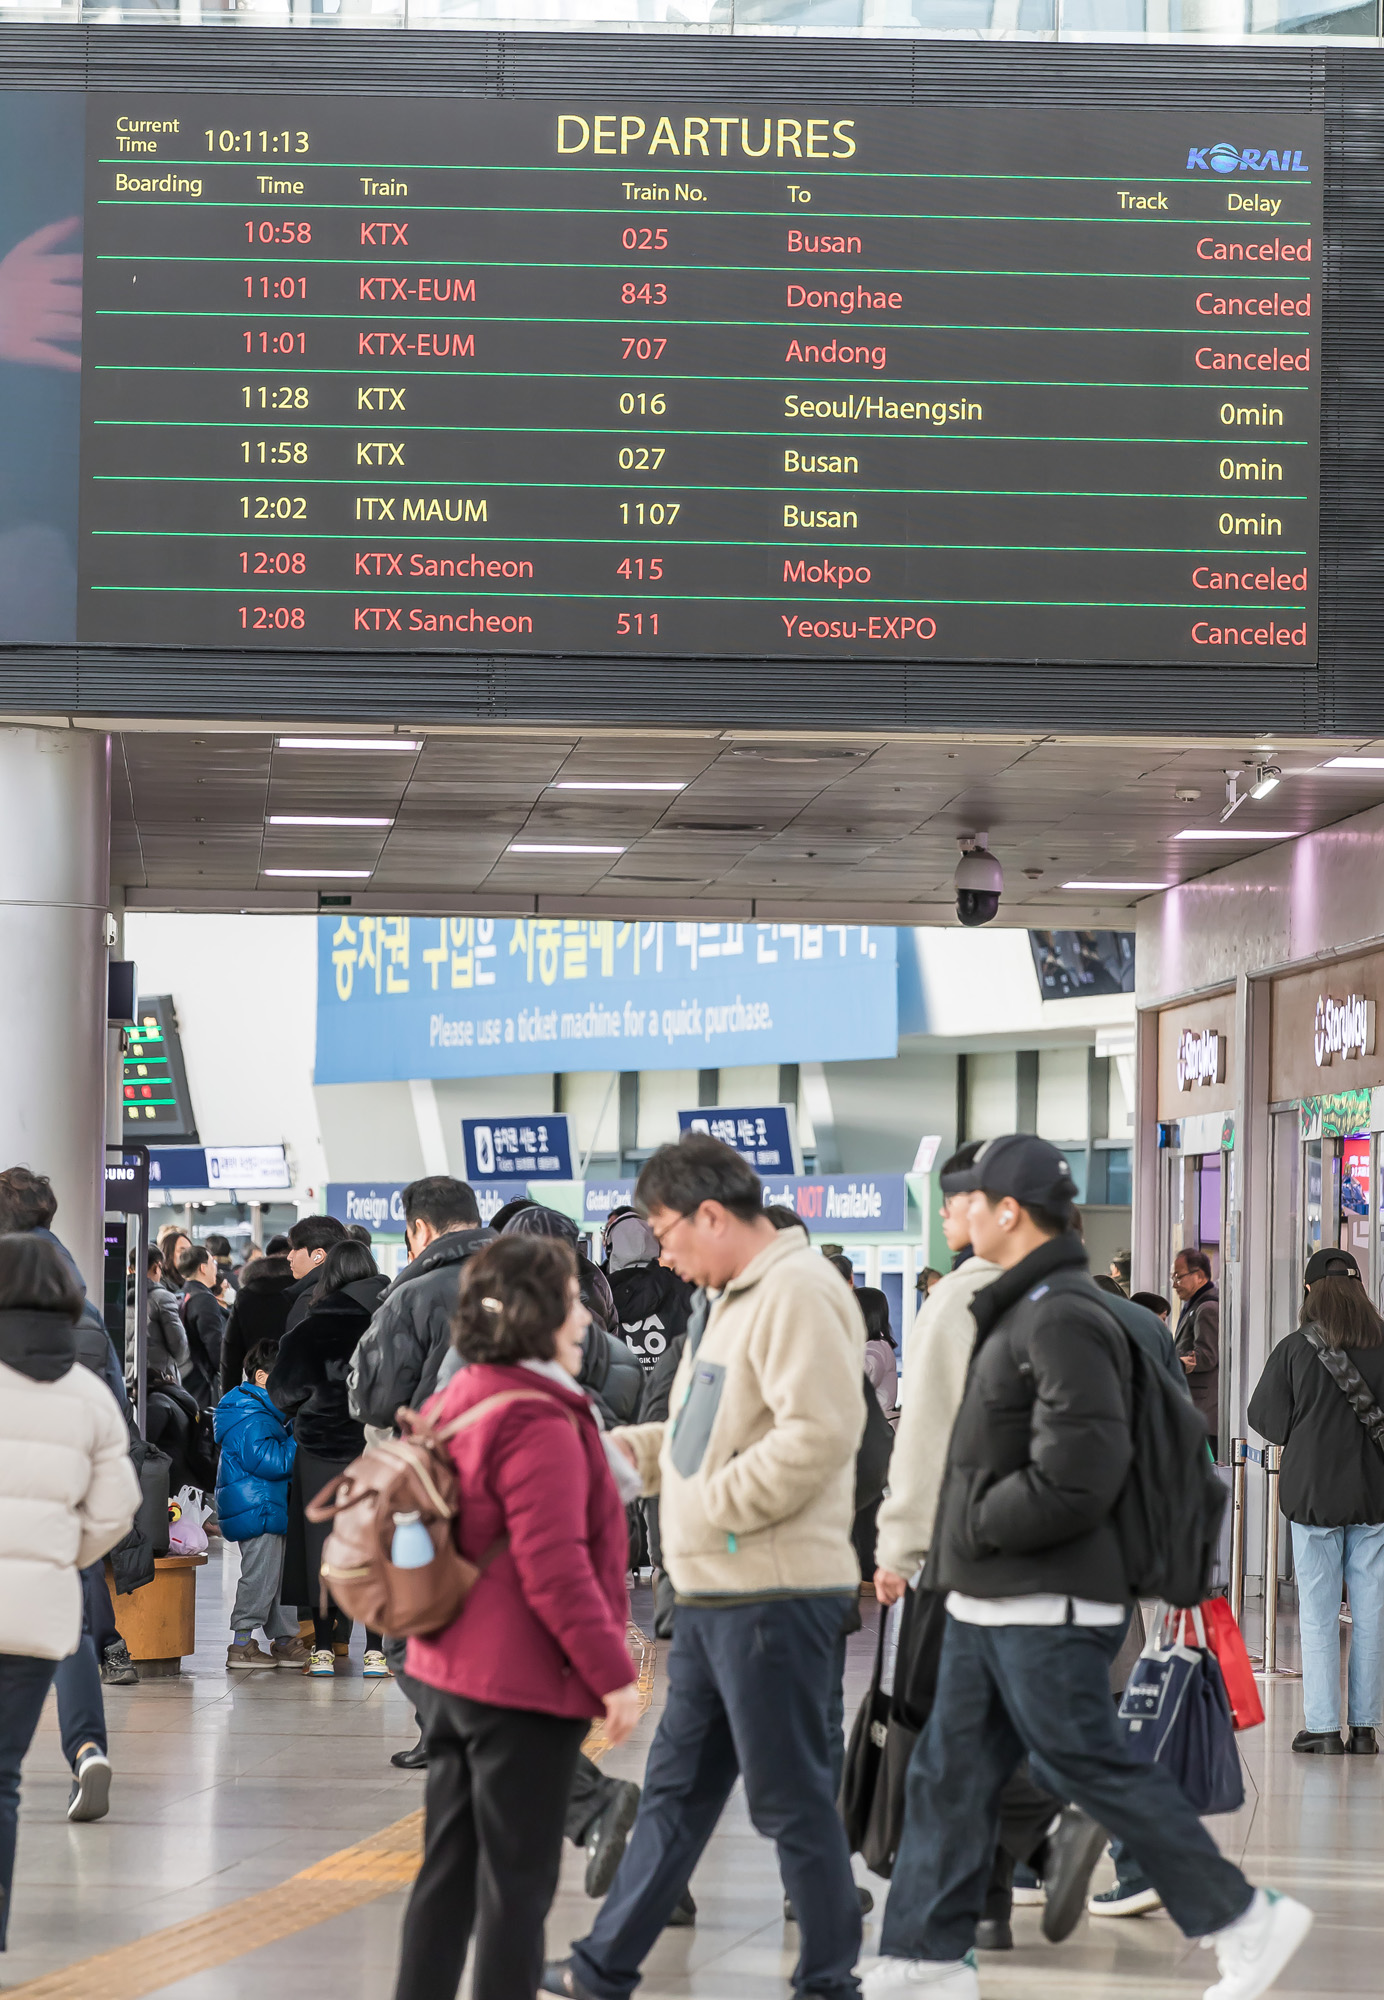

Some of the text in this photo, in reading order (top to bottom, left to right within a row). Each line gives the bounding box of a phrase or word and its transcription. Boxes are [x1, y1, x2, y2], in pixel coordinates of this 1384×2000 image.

[116, 116, 180, 133] Current
[116, 136, 158, 153] Time
[204, 129, 310, 154] 10:11:13
[556, 114, 857, 159] DEPARTURES
[115, 173, 1283, 217] Boarding Time Train Train No. To Track Delay
[244, 220, 1313, 262] 10:58 KTX 025 Busan Canceled
[243, 275, 1312, 317] 11:01 KTX-EUM 843 Donghae Canceled
[242, 330, 1311, 372] 11:01 KTX-EUM 707 Andong Canceled
[241, 385, 1284, 426] 11:28 KTX 016 Seoul/Haengsin 0min
[240, 440, 1283, 481] 11:58 KTX 027 Busan 0min
[239, 496, 1282, 536] 12:02 ITX MAUM 1107 Busan 0min
[239, 551, 1308, 592] 12:08 KTX Sancheon 415 Mokpo Canceled
[237, 606, 1307, 647] 12:08 KTX Sancheon 511 Yeosu-EXPO Canceled
[430, 994, 773, 1047] Please use a ticket machine for a quick purchase.
[346, 1189, 388, 1229] Foreign
[797, 1185, 824, 1218] NOT
[825, 1182, 882, 1219] Available
